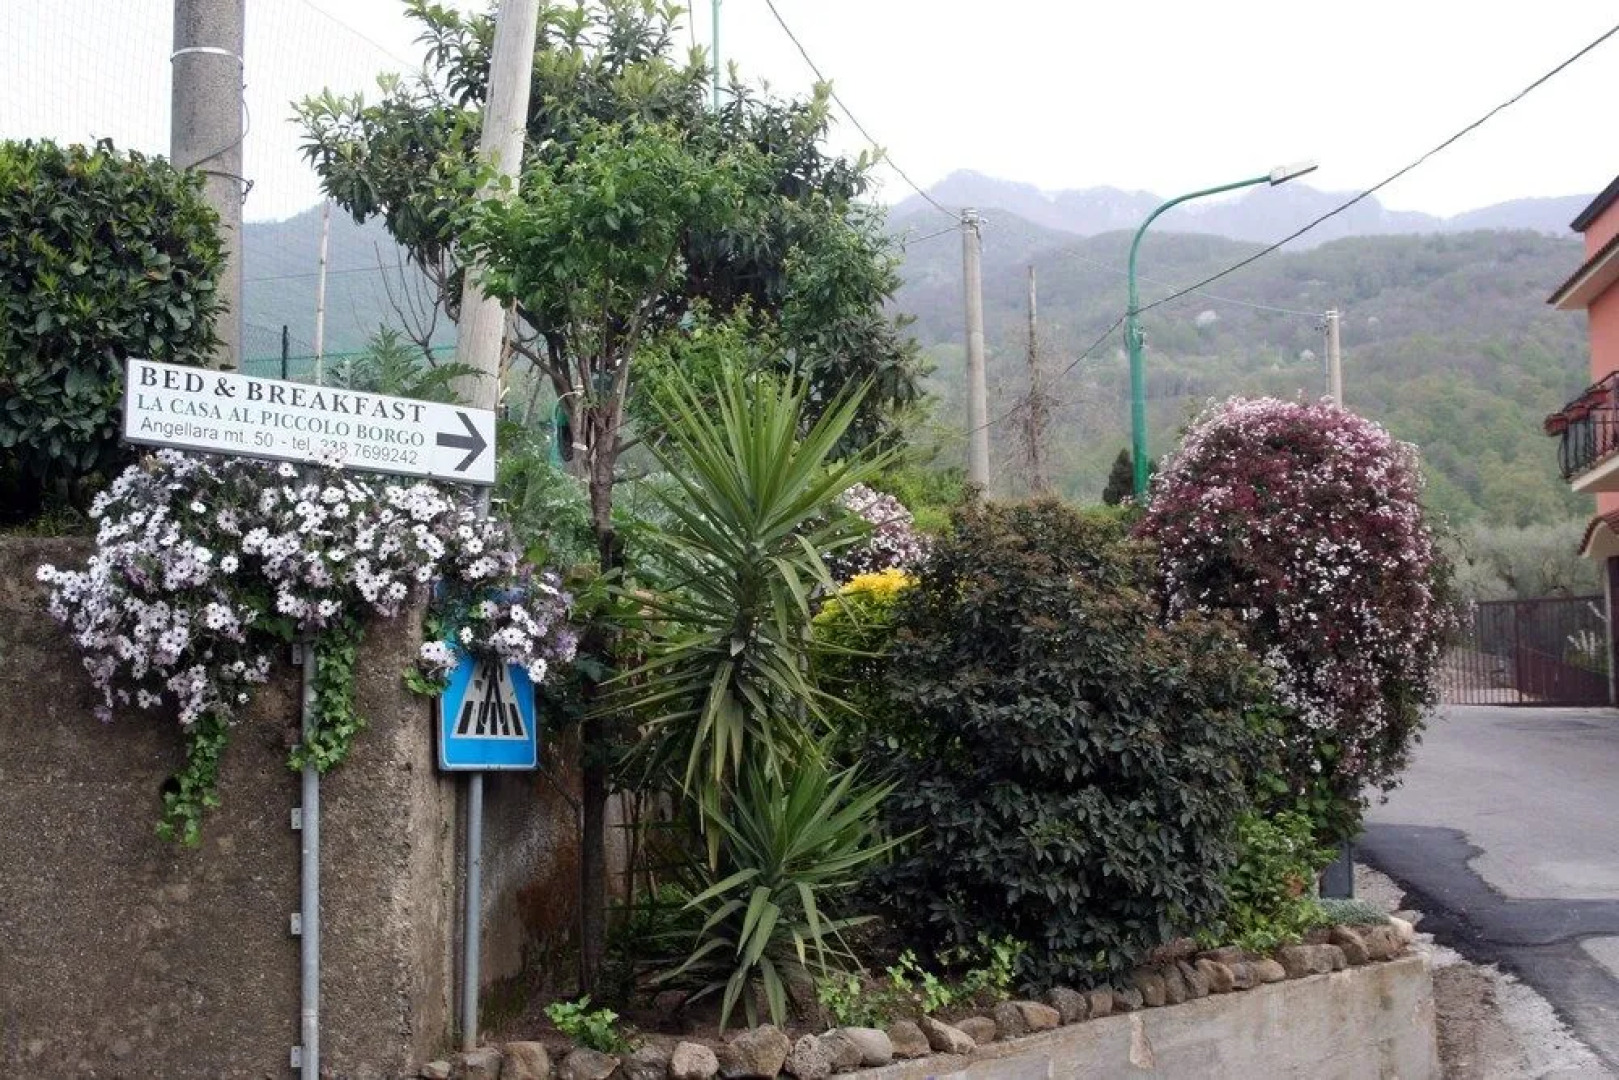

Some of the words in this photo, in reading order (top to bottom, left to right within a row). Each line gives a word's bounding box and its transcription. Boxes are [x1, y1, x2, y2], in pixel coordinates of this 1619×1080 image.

[137, 393, 163, 412] LA
[170, 398, 222, 420] CASA
[228, 407, 254, 424] AL
[261, 410, 350, 437] PICCOLO
[357, 423, 425, 447] BORGO
[139, 366, 205, 393] BED
[214, 376, 236, 398] &
[247, 381, 427, 423] BREAKFAST
[140, 416, 218, 440] Angellara
[254, 431, 273, 447] 50
